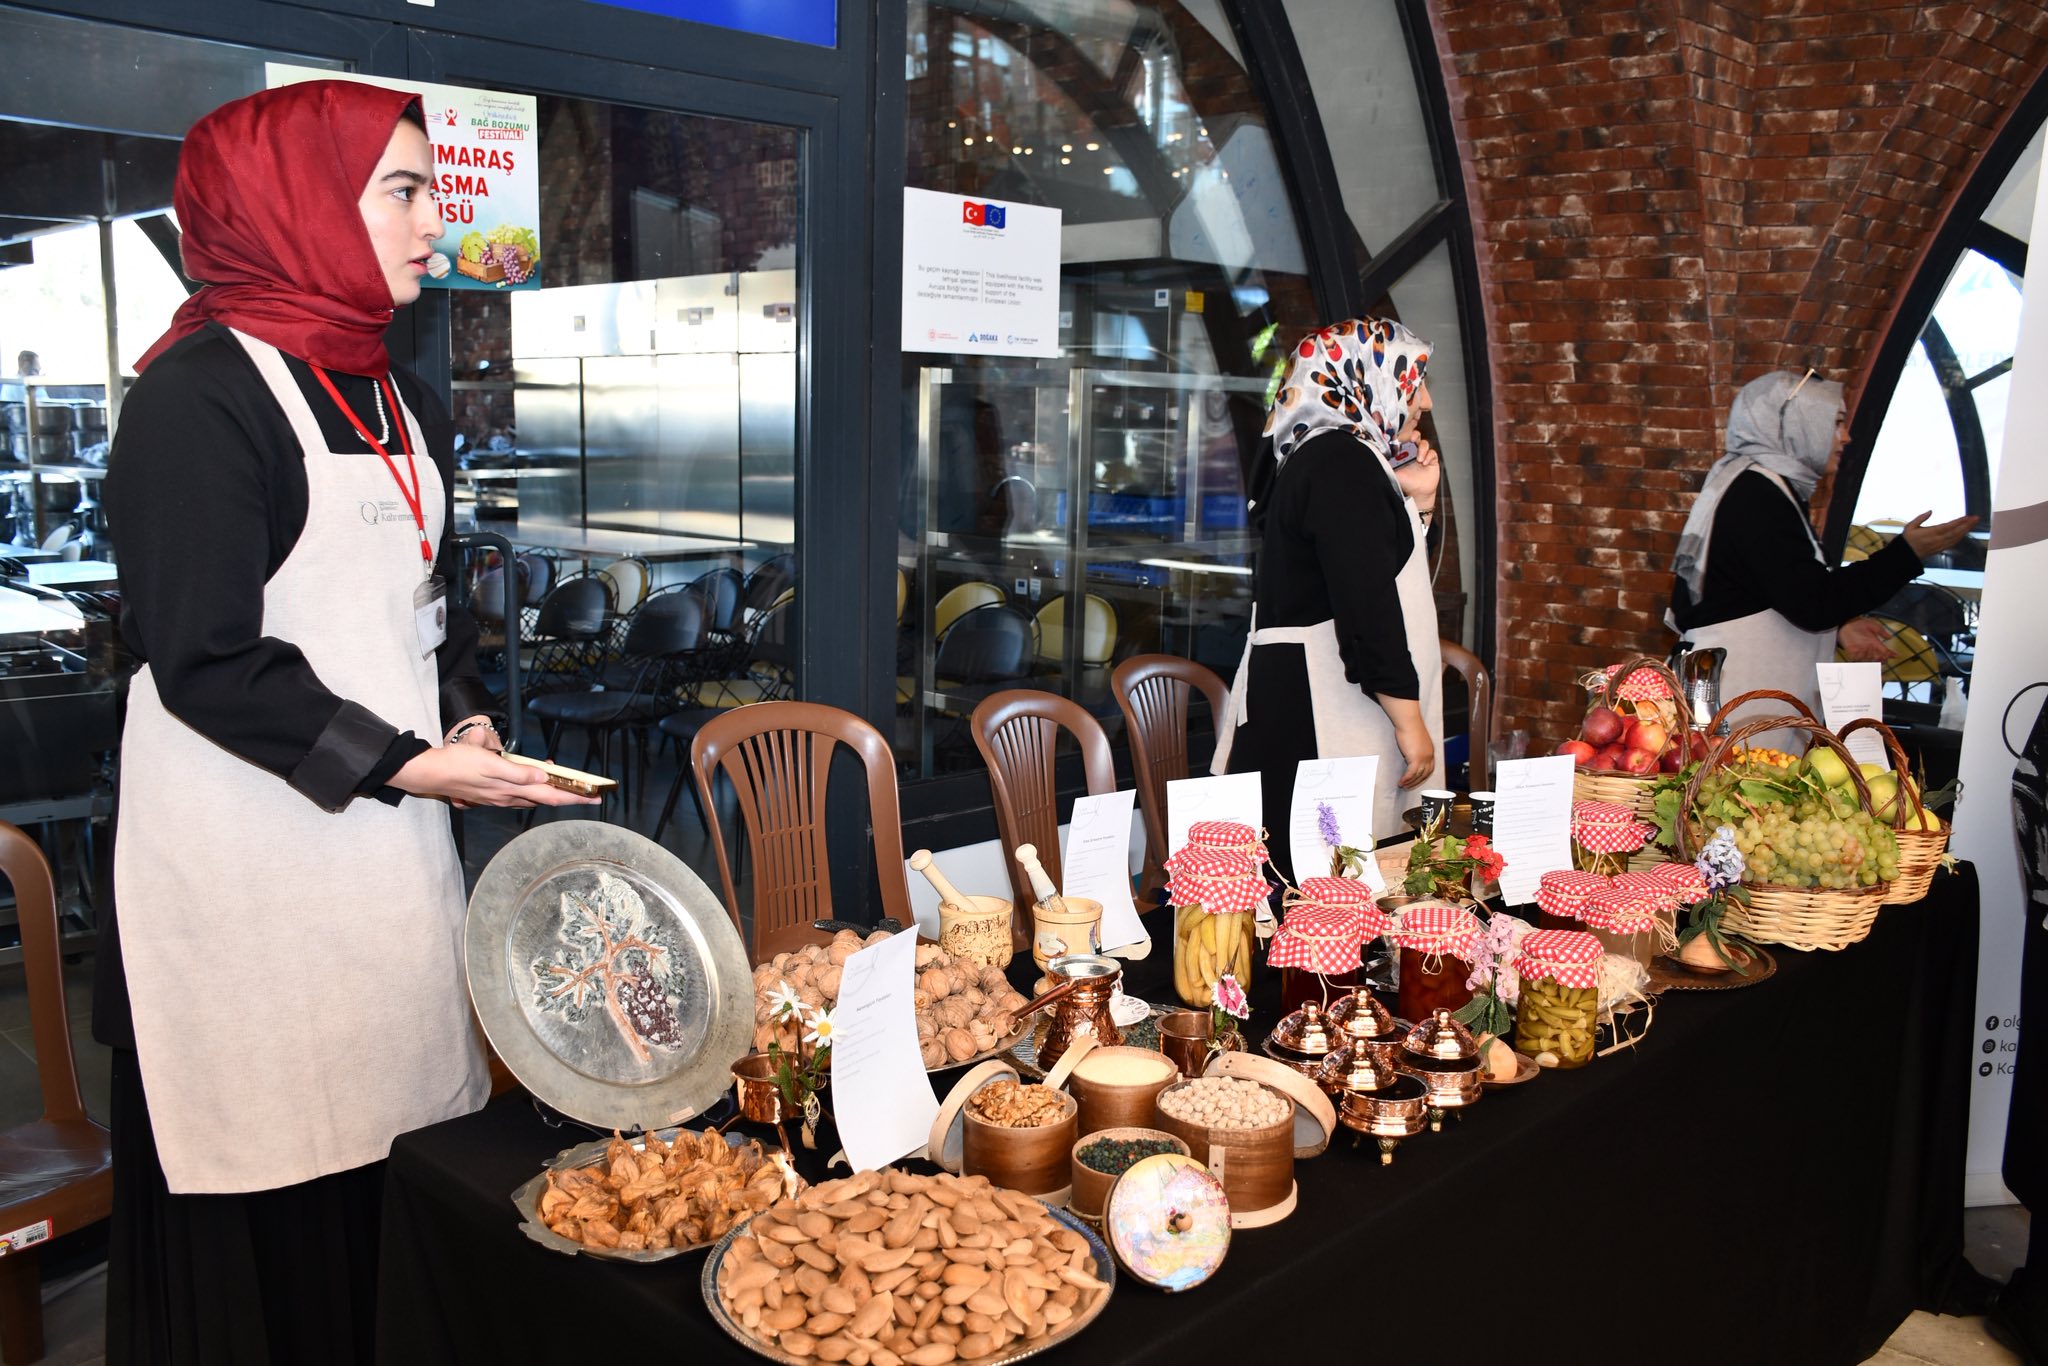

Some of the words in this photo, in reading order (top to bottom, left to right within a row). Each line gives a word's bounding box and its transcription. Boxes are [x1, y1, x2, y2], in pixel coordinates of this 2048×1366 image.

[471, 117, 489, 128] BAĞ
[492, 121, 530, 132] BOZUMU
[479, 130, 523, 140] FESTİVALİ
[2000, 1040, 2017, 1052] ka
